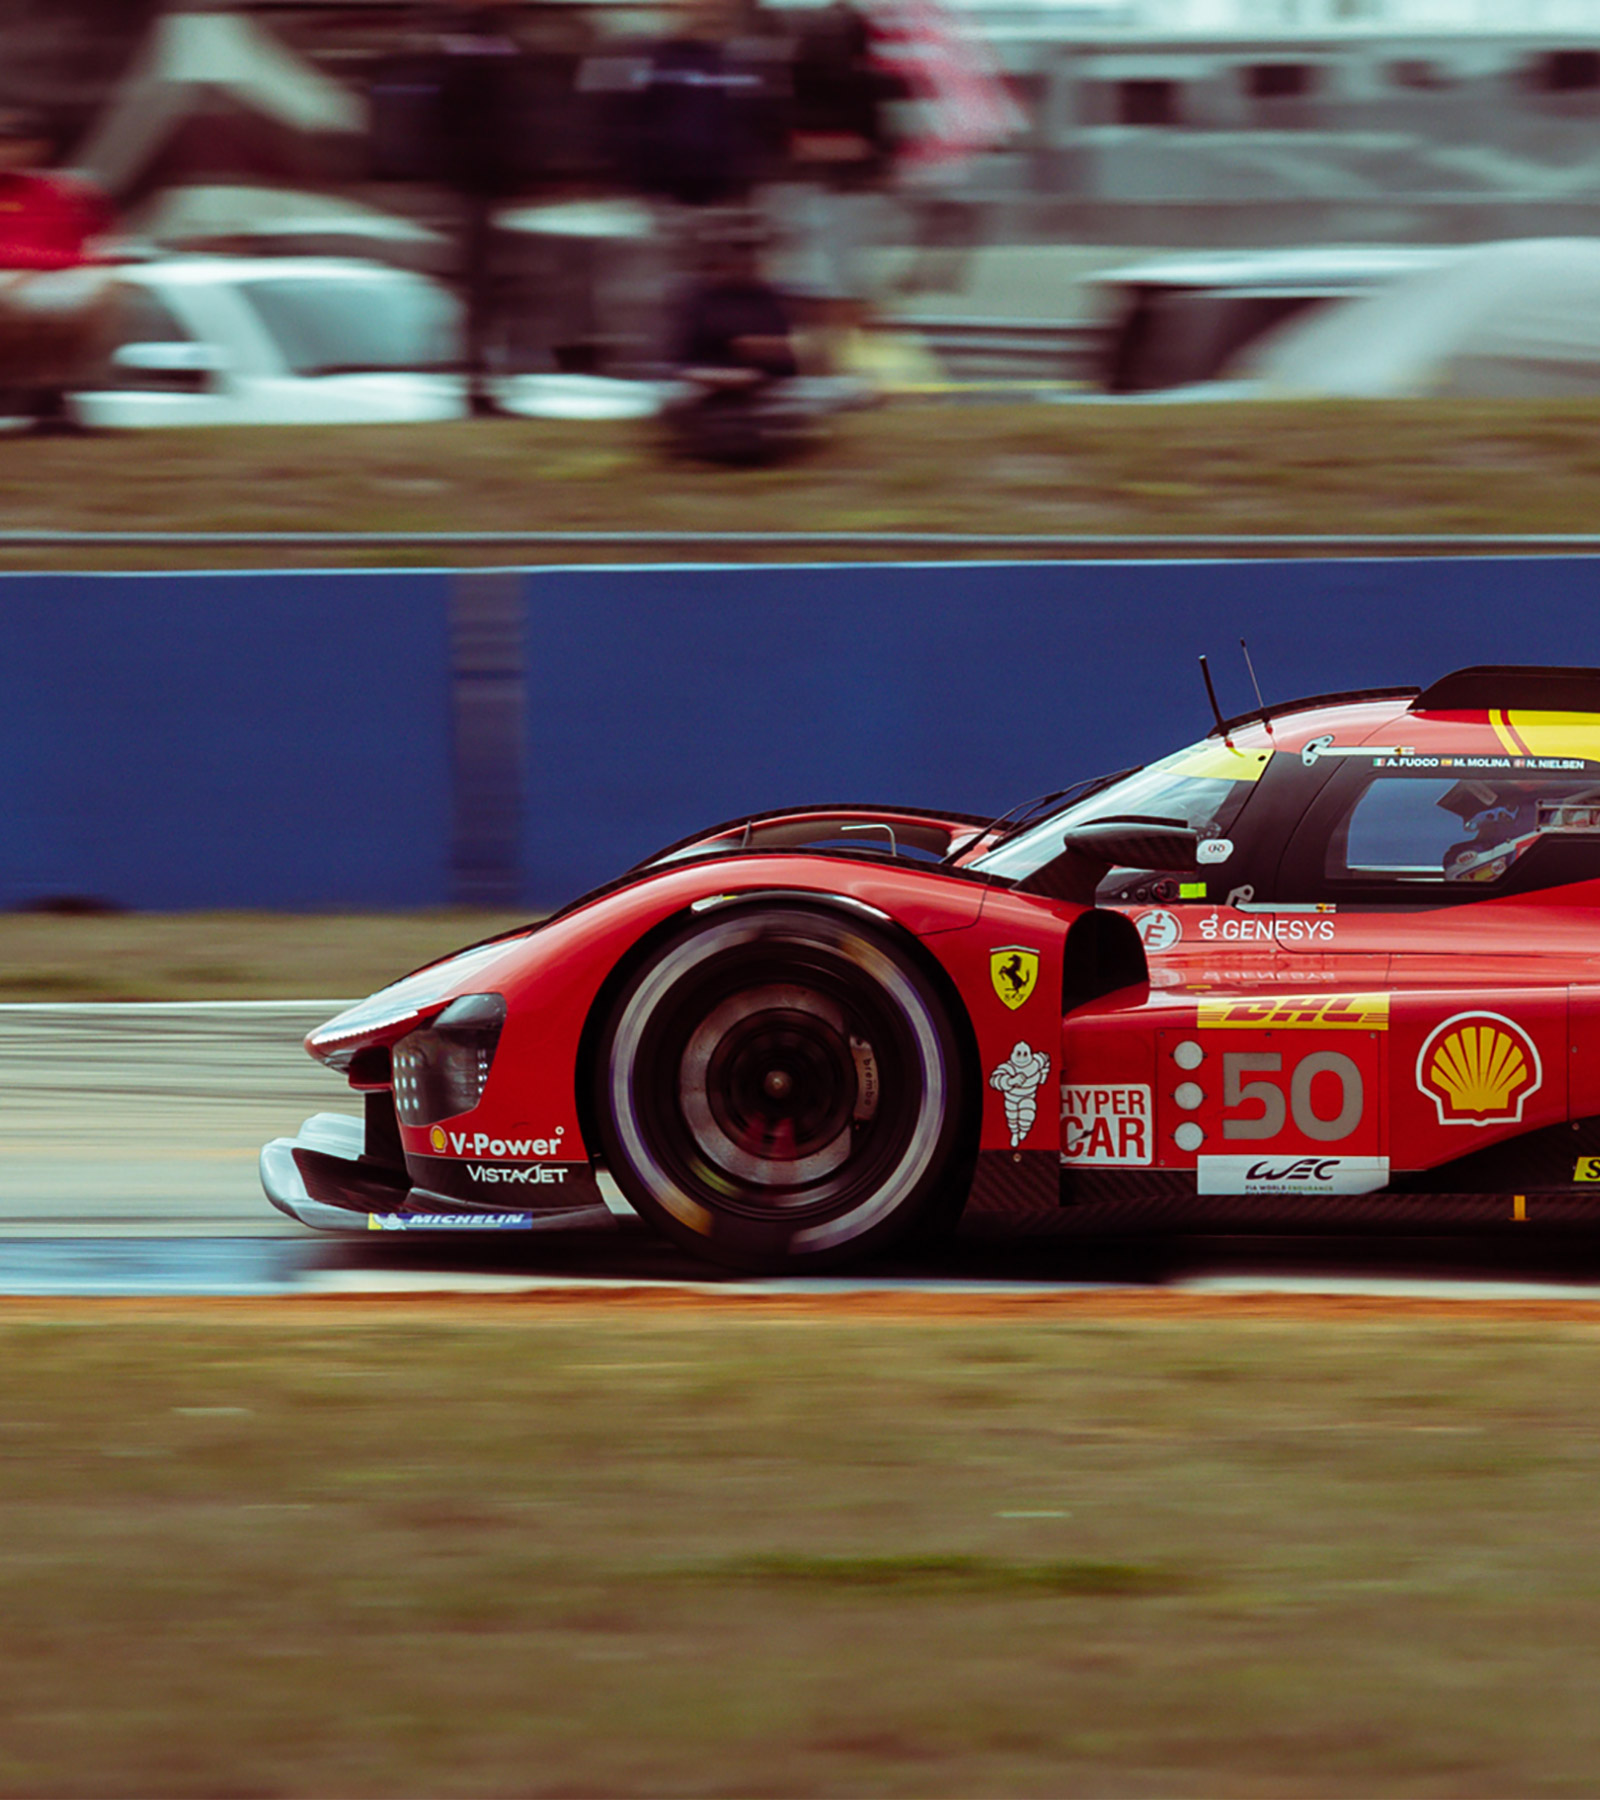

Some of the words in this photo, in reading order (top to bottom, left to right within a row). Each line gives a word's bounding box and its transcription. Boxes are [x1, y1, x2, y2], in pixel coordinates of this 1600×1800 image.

[1400, 758, 1439, 767] FUOCO
[1468, 758, 1511, 768] MOLINA
[1539, 760, 1585, 769] NIELSEN
[1222, 919, 1335, 941] GENESYS
[1223, 998, 1367, 1022] DHL
[1060, 1090, 1146, 1115] HYPER
[1222, 1050, 1364, 1142] 50
[449, 1132, 562, 1156] V-Power
[1060, 1116, 1146, 1158] CAR
[1245, 1158, 1341, 1181] WEC
[407, 1213, 524, 1226] MICHELIN
